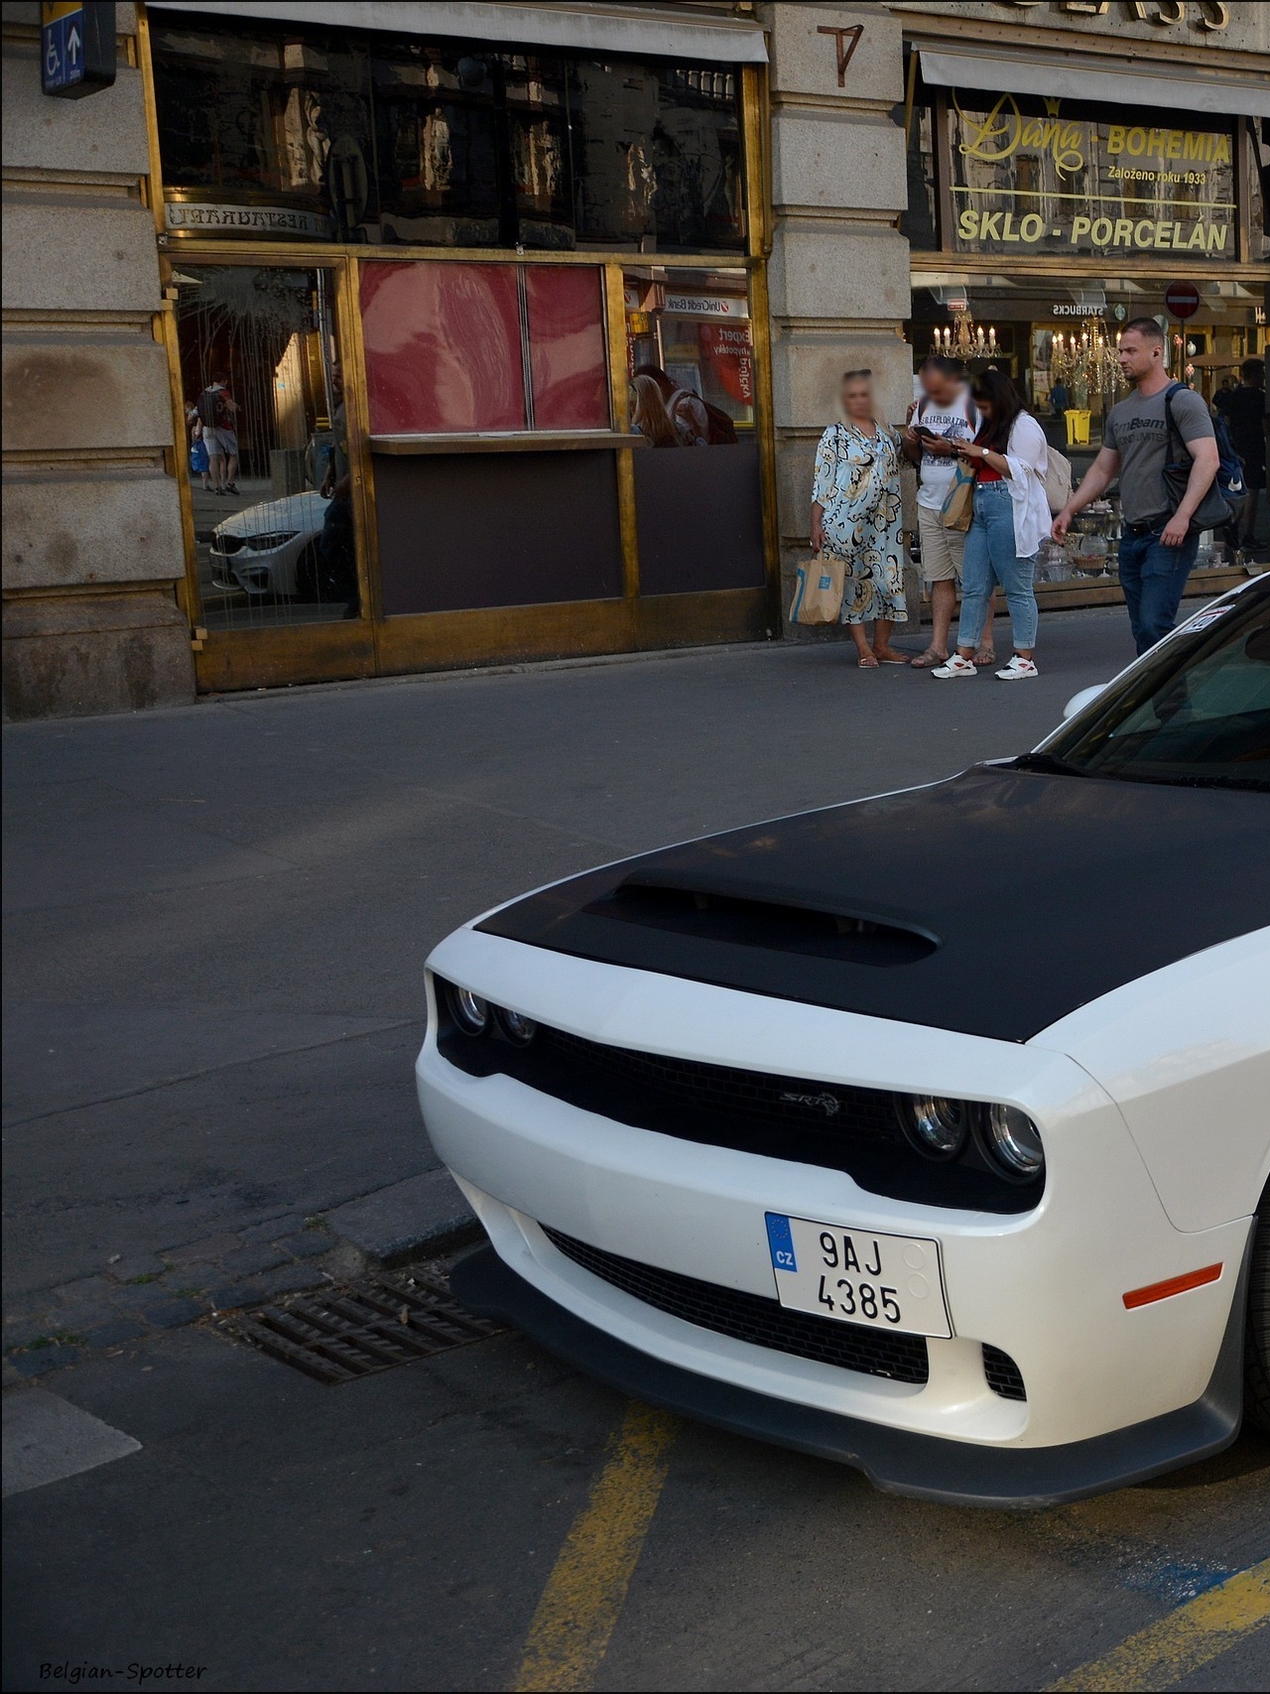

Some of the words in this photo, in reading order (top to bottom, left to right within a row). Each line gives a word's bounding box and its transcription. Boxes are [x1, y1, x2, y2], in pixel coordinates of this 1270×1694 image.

[952, 87, 1084, 182] Dana
[1107, 125, 1229, 163] BOHEMIA
[1108, 166, 1155, 181] Založeno
[1157, 171, 1180, 184] roku
[1183, 172, 1206, 185] 1933
[958, 210, 1043, 242] SKLO
[1071, 214, 1227, 250] PORCELÁN
[776, 1250, 793, 1266] CZ
[819, 1231, 882, 1276] 9AJ
[818, 1275, 901, 1324] 4385
